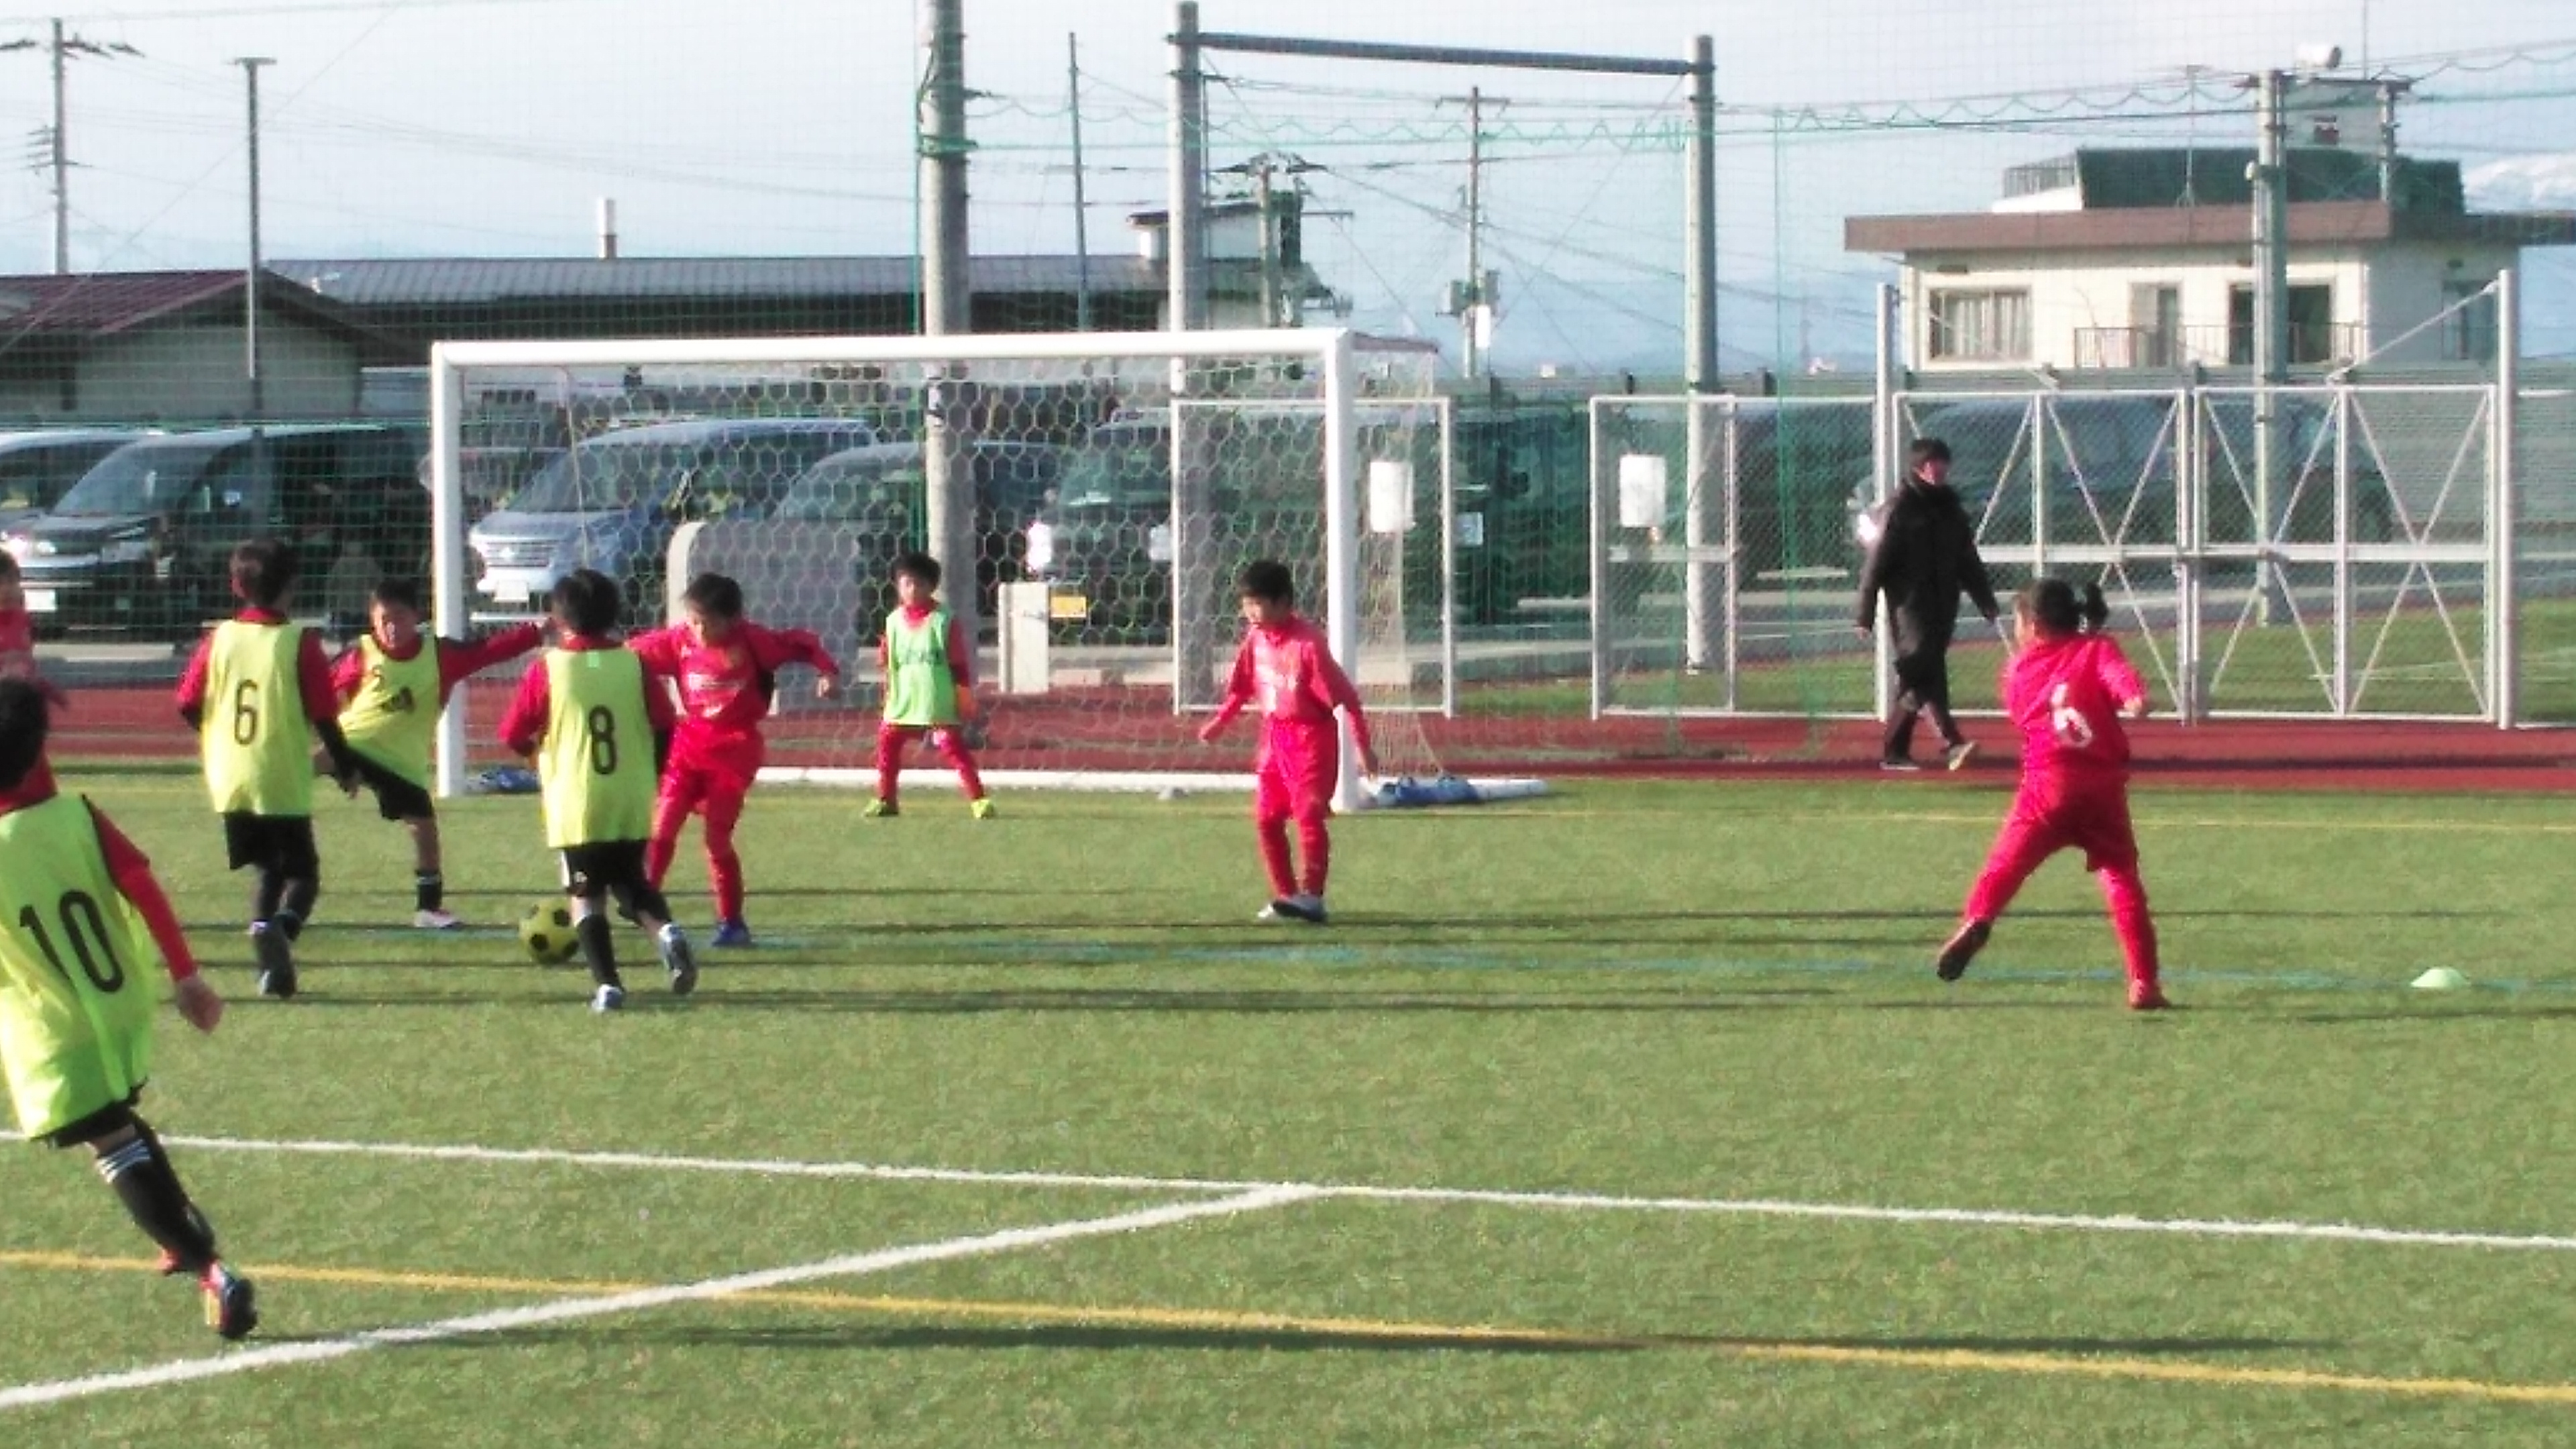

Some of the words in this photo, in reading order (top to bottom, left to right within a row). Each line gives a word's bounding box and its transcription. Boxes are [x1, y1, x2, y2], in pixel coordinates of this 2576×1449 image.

[235, 679, 258, 746] 6
[589, 706, 616, 775] 8
[2051, 683, 2092, 749] 6
[19, 890, 123, 993] 10
